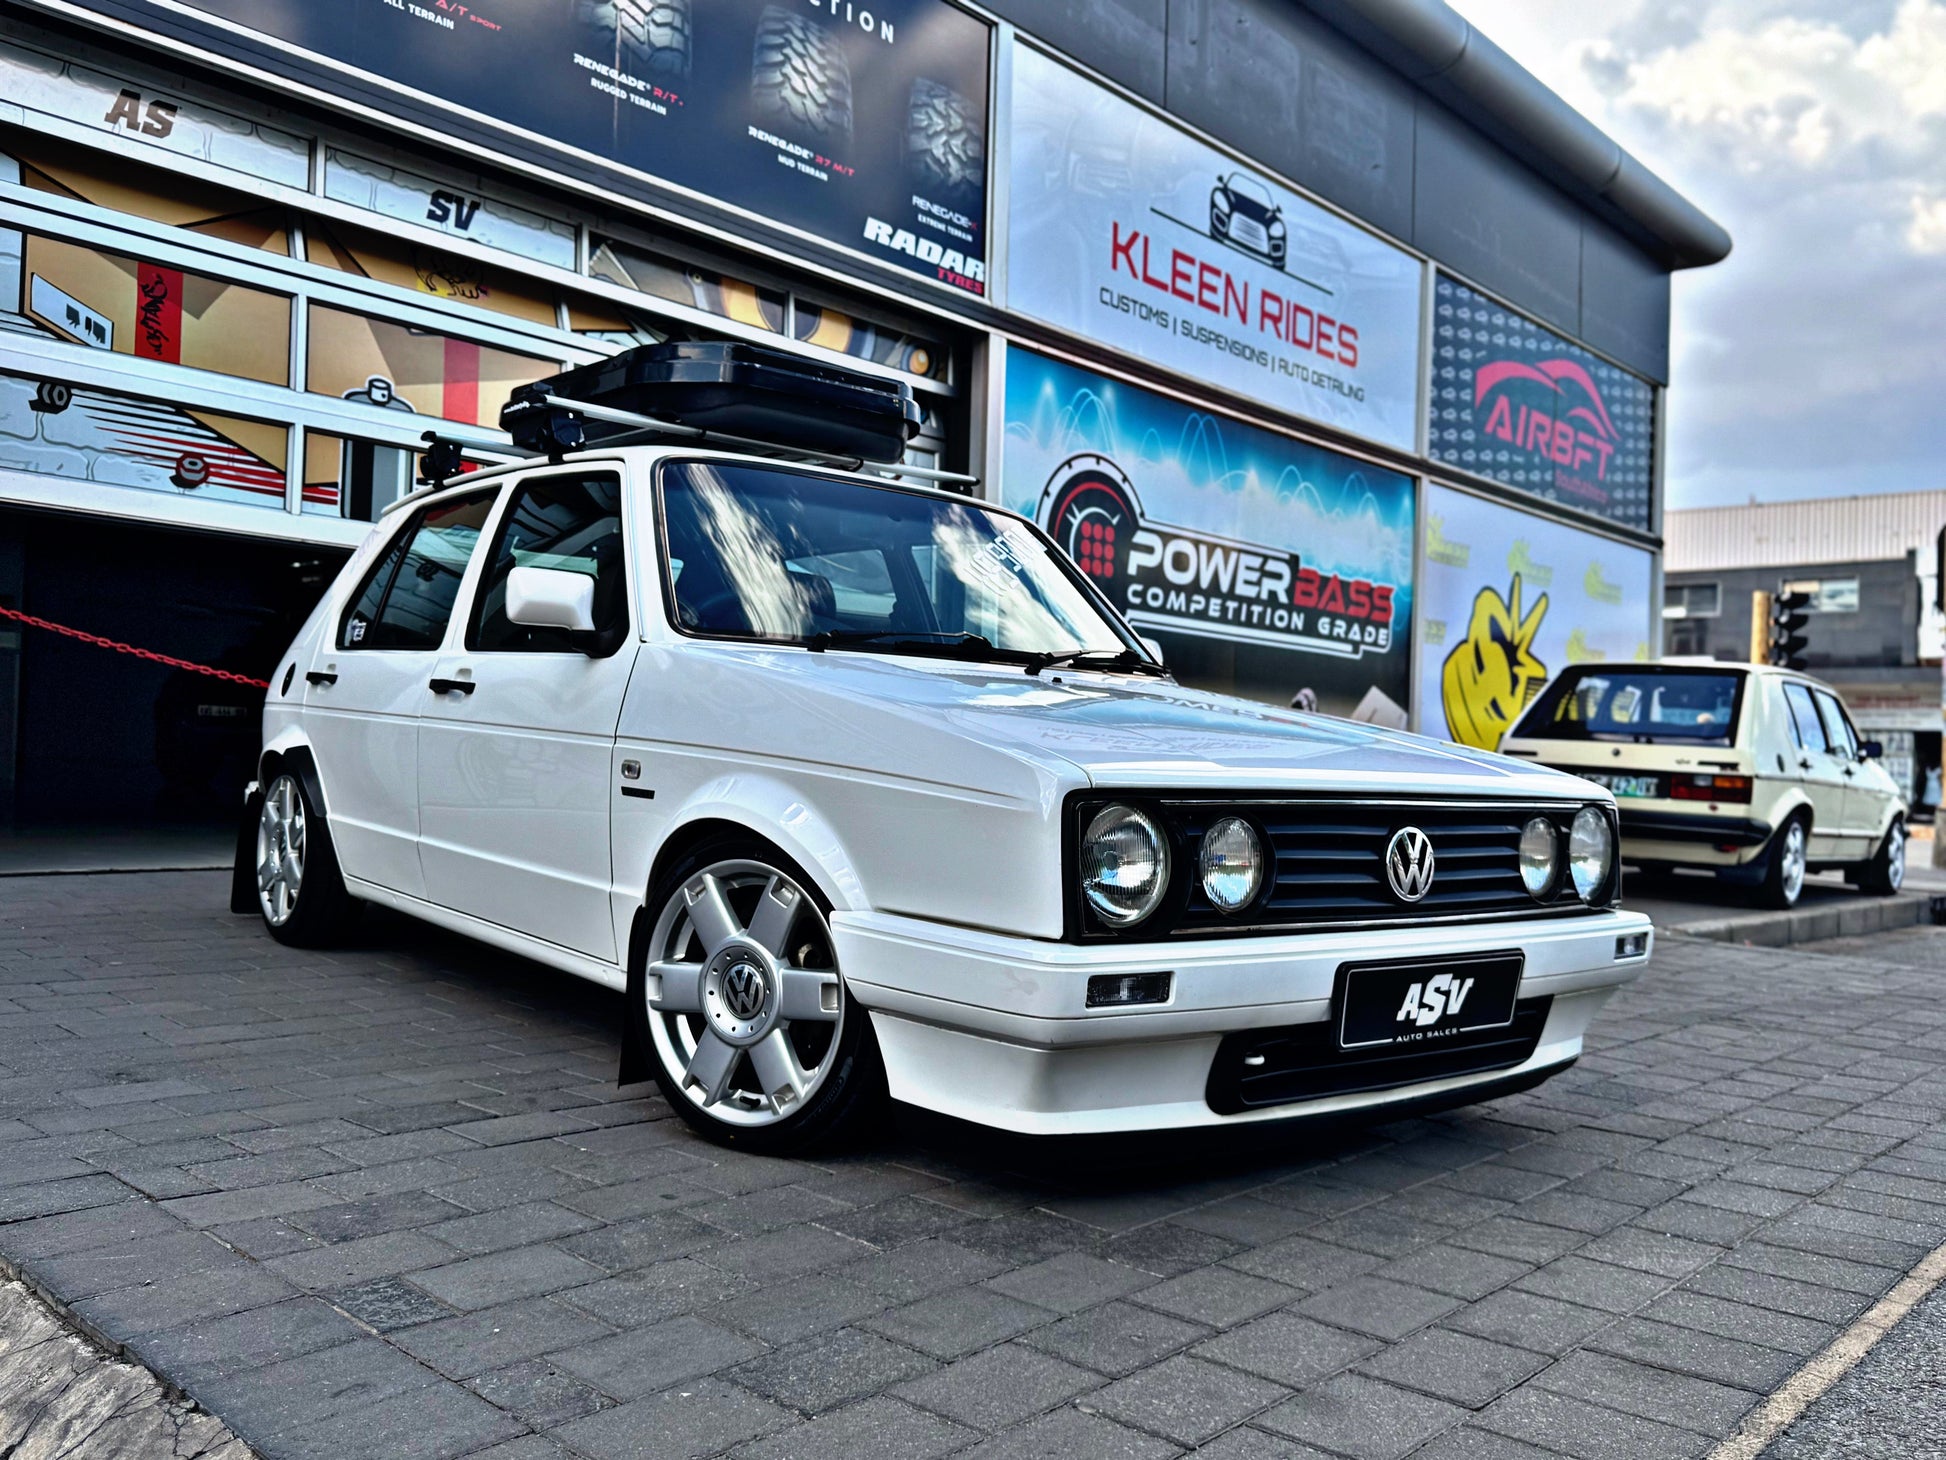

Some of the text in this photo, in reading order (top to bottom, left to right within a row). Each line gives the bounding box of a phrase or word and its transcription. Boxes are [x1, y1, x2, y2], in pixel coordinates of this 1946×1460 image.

[407, 3, 455, 30] TERRAIN
[809, 0, 894, 44] TION
[103, 88, 179, 139] AS
[590, 77, 667, 116] RUGGED TERRAIN
[796, 161, 829, 182] TERRAIN
[425, 189, 481, 231] SV
[863, 216, 985, 283] RADAR
[937, 266, 984, 294] TYRES
[1111, 221, 1359, 369] KLEEN RIDES
[1099, 286, 1365, 403] CUSTOMS SUSPENSIONS AUTO DETAILING
[1484, 394, 1615, 481] AIRBFT
[1126, 583, 1305, 633] COMPETITION
[1316, 618, 1391, 648] GRADE
[1396, 973, 1475, 1027] ASV
[1395, 1026, 1459, 1044] AUTO SALES
